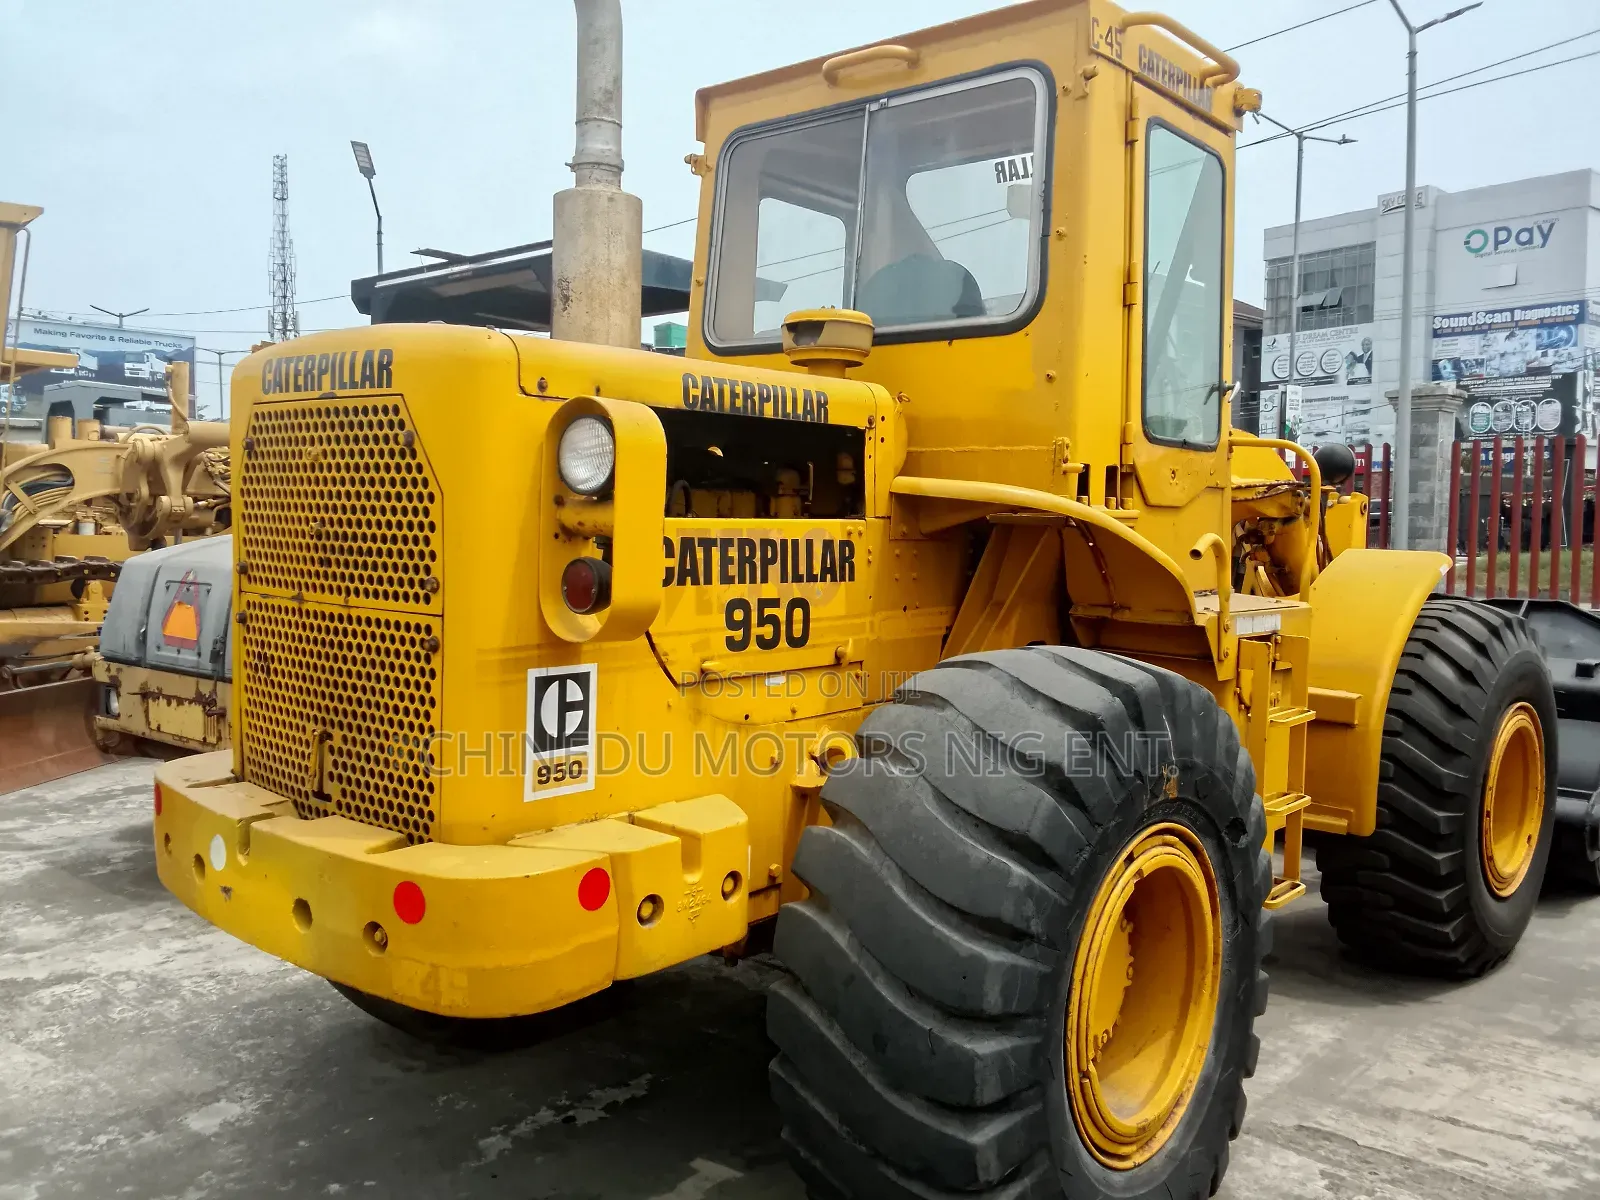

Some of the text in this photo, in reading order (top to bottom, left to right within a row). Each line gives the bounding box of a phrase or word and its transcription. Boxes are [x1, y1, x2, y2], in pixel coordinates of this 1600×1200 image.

[1091, 16, 1123, 61] C-45
[1463, 222, 1556, 255] OPay
[33, 327, 68, 338] Making
[69, 331, 107, 341] Favorite
[118, 336, 152, 346] Reliable
[154, 340, 183, 349] Trucks
[1433, 309, 1512, 329] SoundScan
[1513, 303, 1580, 322] Diagnostics
[261, 348, 394, 395] CATERPILLAR
[681, 372, 830, 425] CATERPILLAR
[662, 535, 856, 588] CATERPILLAR
[724, 597, 811, 653] 950
[536, 759, 584, 786] 950
